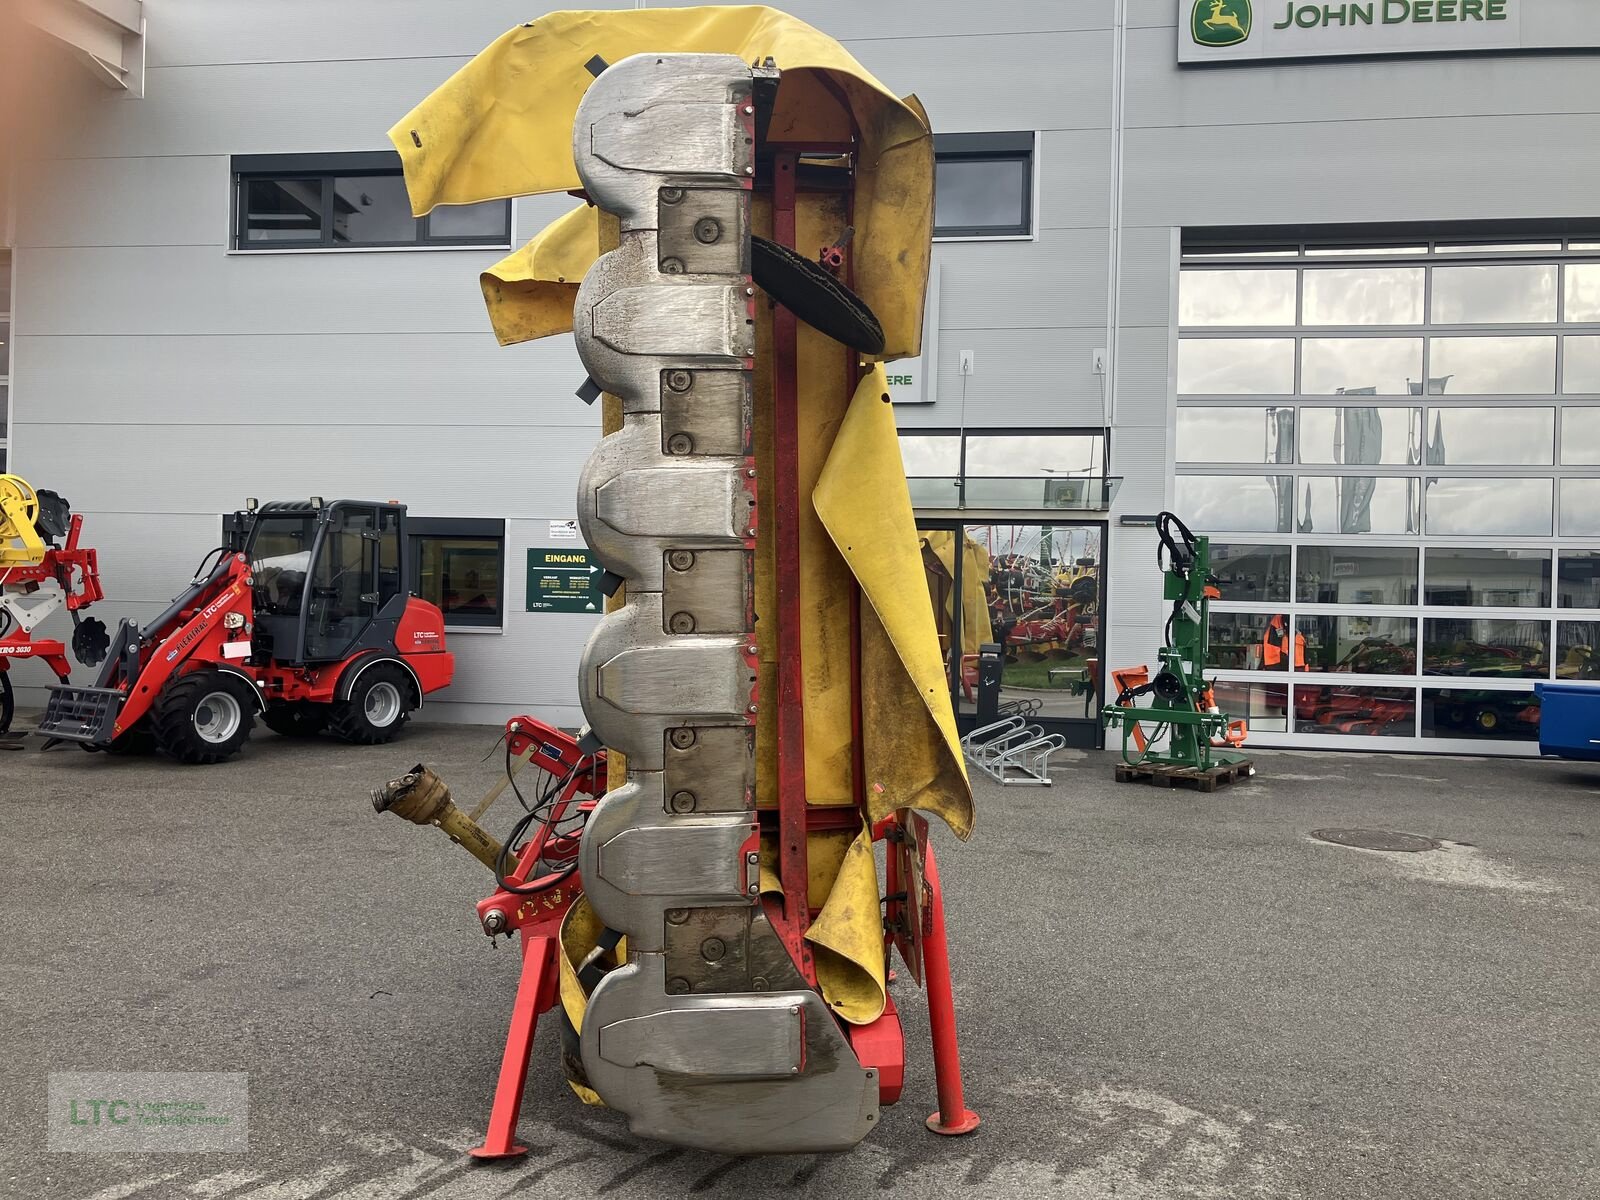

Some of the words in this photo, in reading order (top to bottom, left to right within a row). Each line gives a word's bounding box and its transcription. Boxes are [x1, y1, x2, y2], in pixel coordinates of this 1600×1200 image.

[1273, 2, 1373, 29] JOHN
[1382, 0, 1507, 24] DEERE
[886, 375, 913, 386] ERE
[545, 554, 586, 563] EINGANG
[203, 604, 218, 619] LTC
[413, 631, 424, 639] LTC
